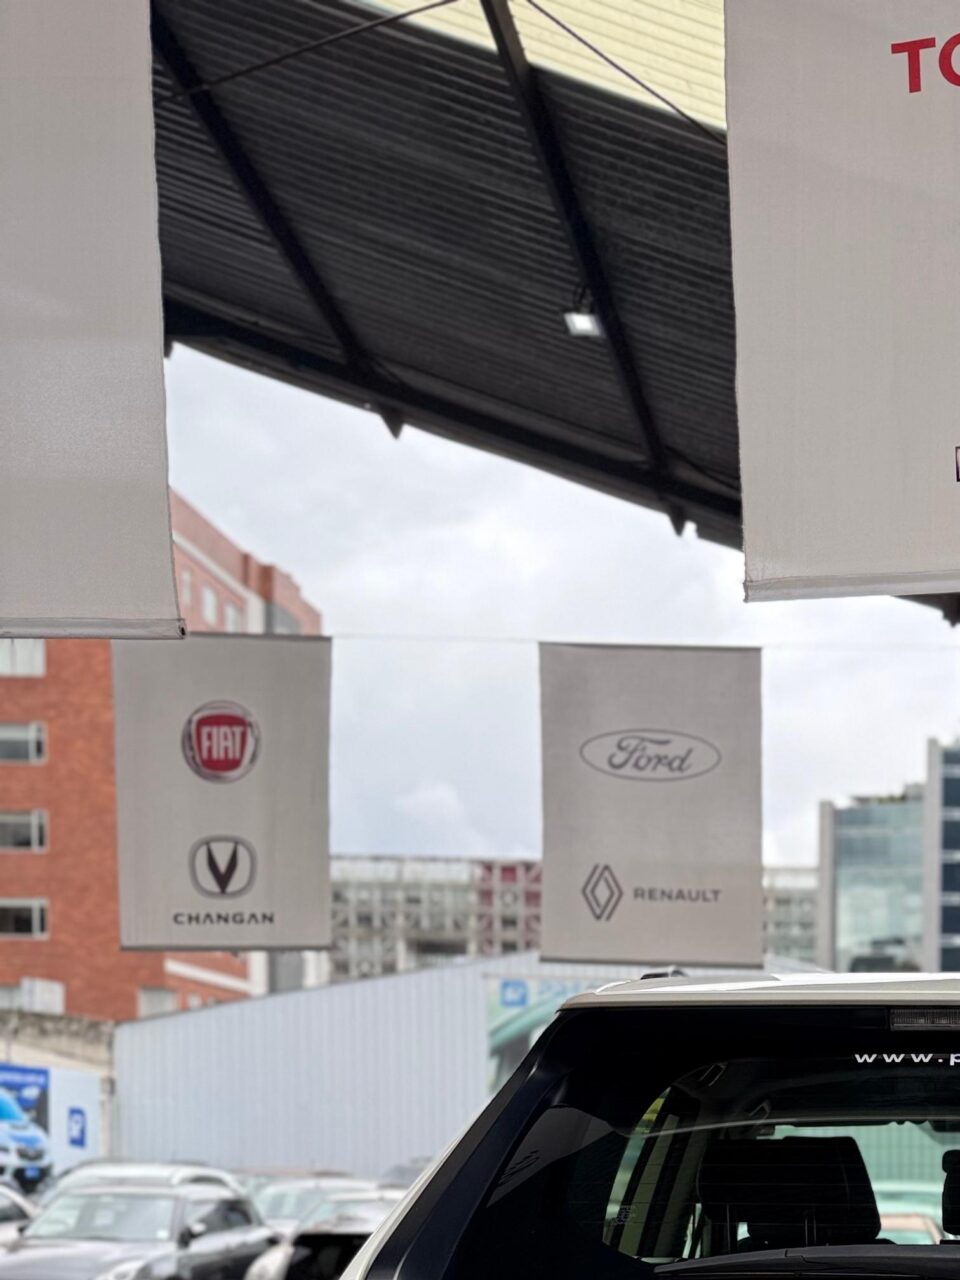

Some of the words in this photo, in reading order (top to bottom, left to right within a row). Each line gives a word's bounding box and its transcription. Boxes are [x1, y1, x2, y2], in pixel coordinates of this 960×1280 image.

[201, 725, 244, 760] FIAT
[607, 735, 694, 773] Ford
[633, 887, 721, 903] RENAULT
[173, 912, 275, 925] CHANGAN
